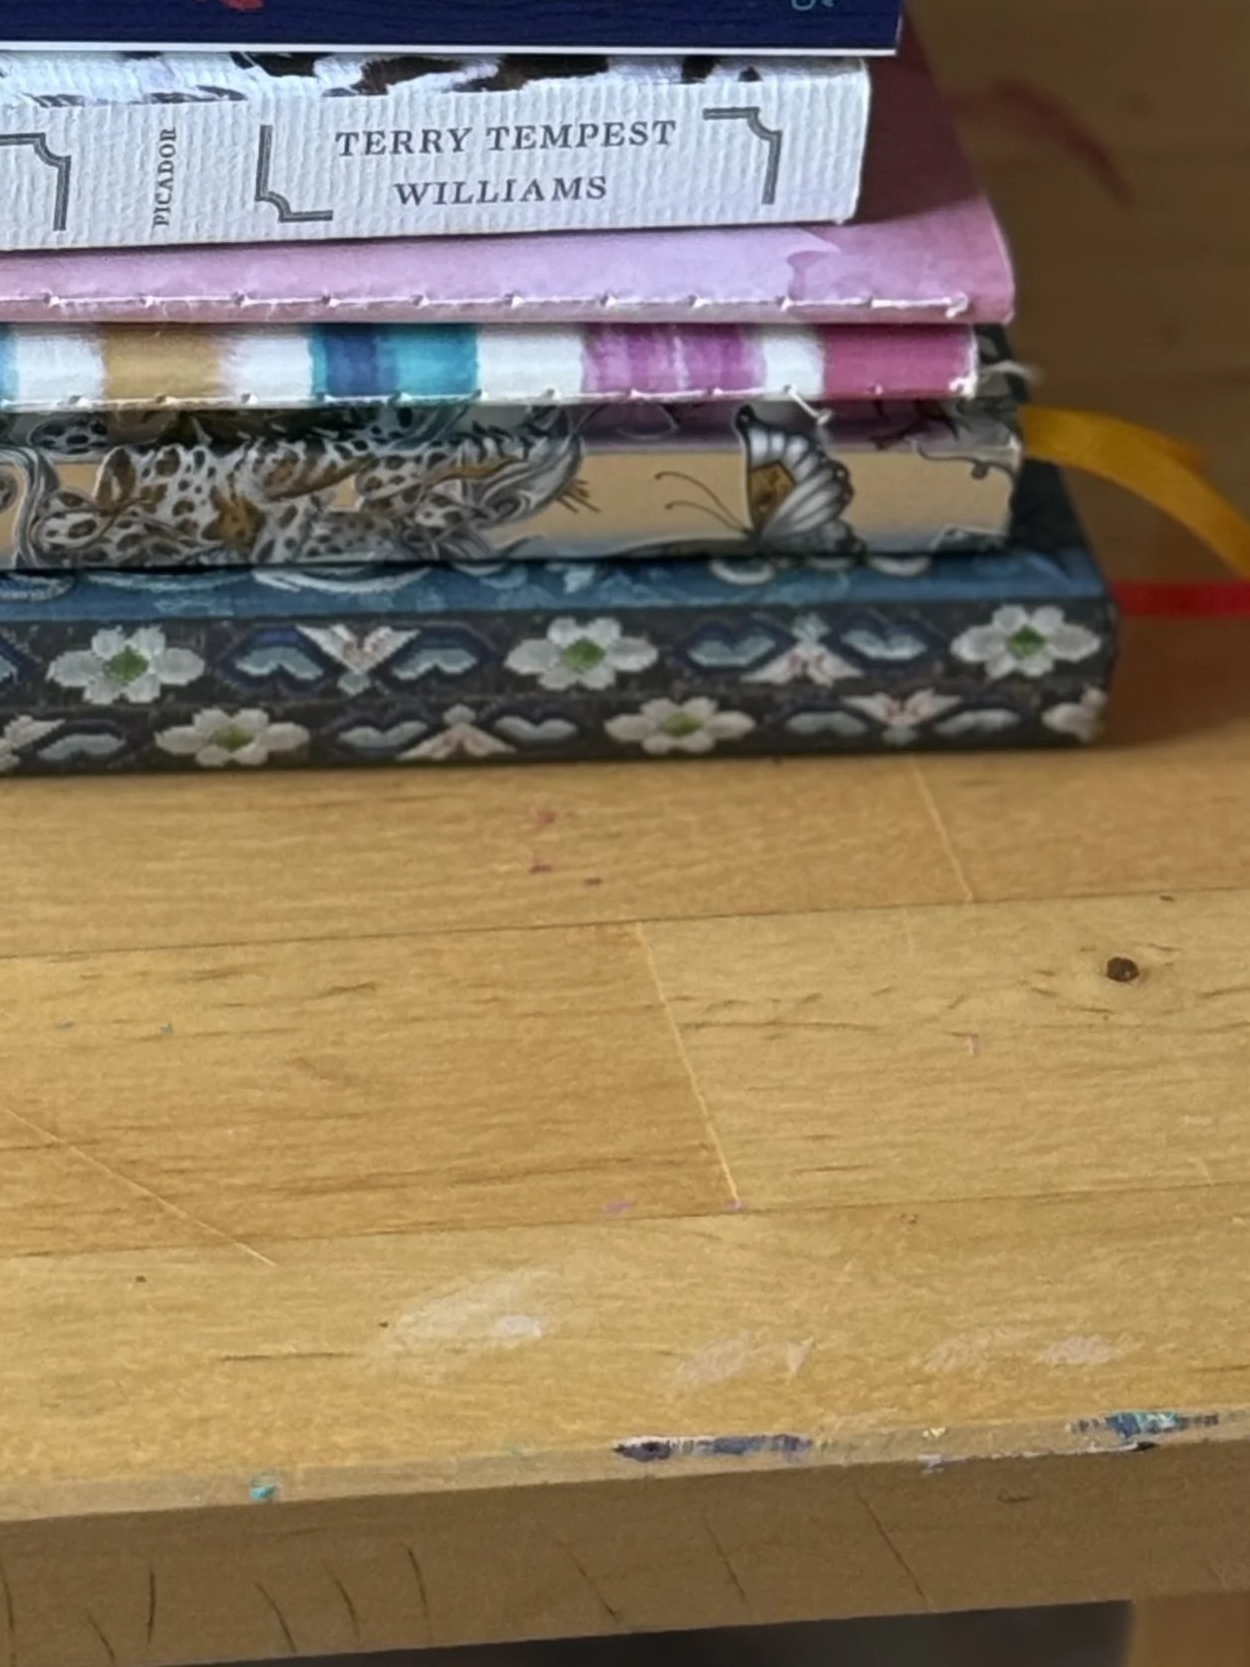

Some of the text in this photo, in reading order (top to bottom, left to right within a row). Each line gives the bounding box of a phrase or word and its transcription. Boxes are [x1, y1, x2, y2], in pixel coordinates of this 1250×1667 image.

[335, 120, 677, 157] TERRY TEMPEST
[153, 127, 175, 227] PICADOR
[395, 176, 608, 206] WILLIAMS
